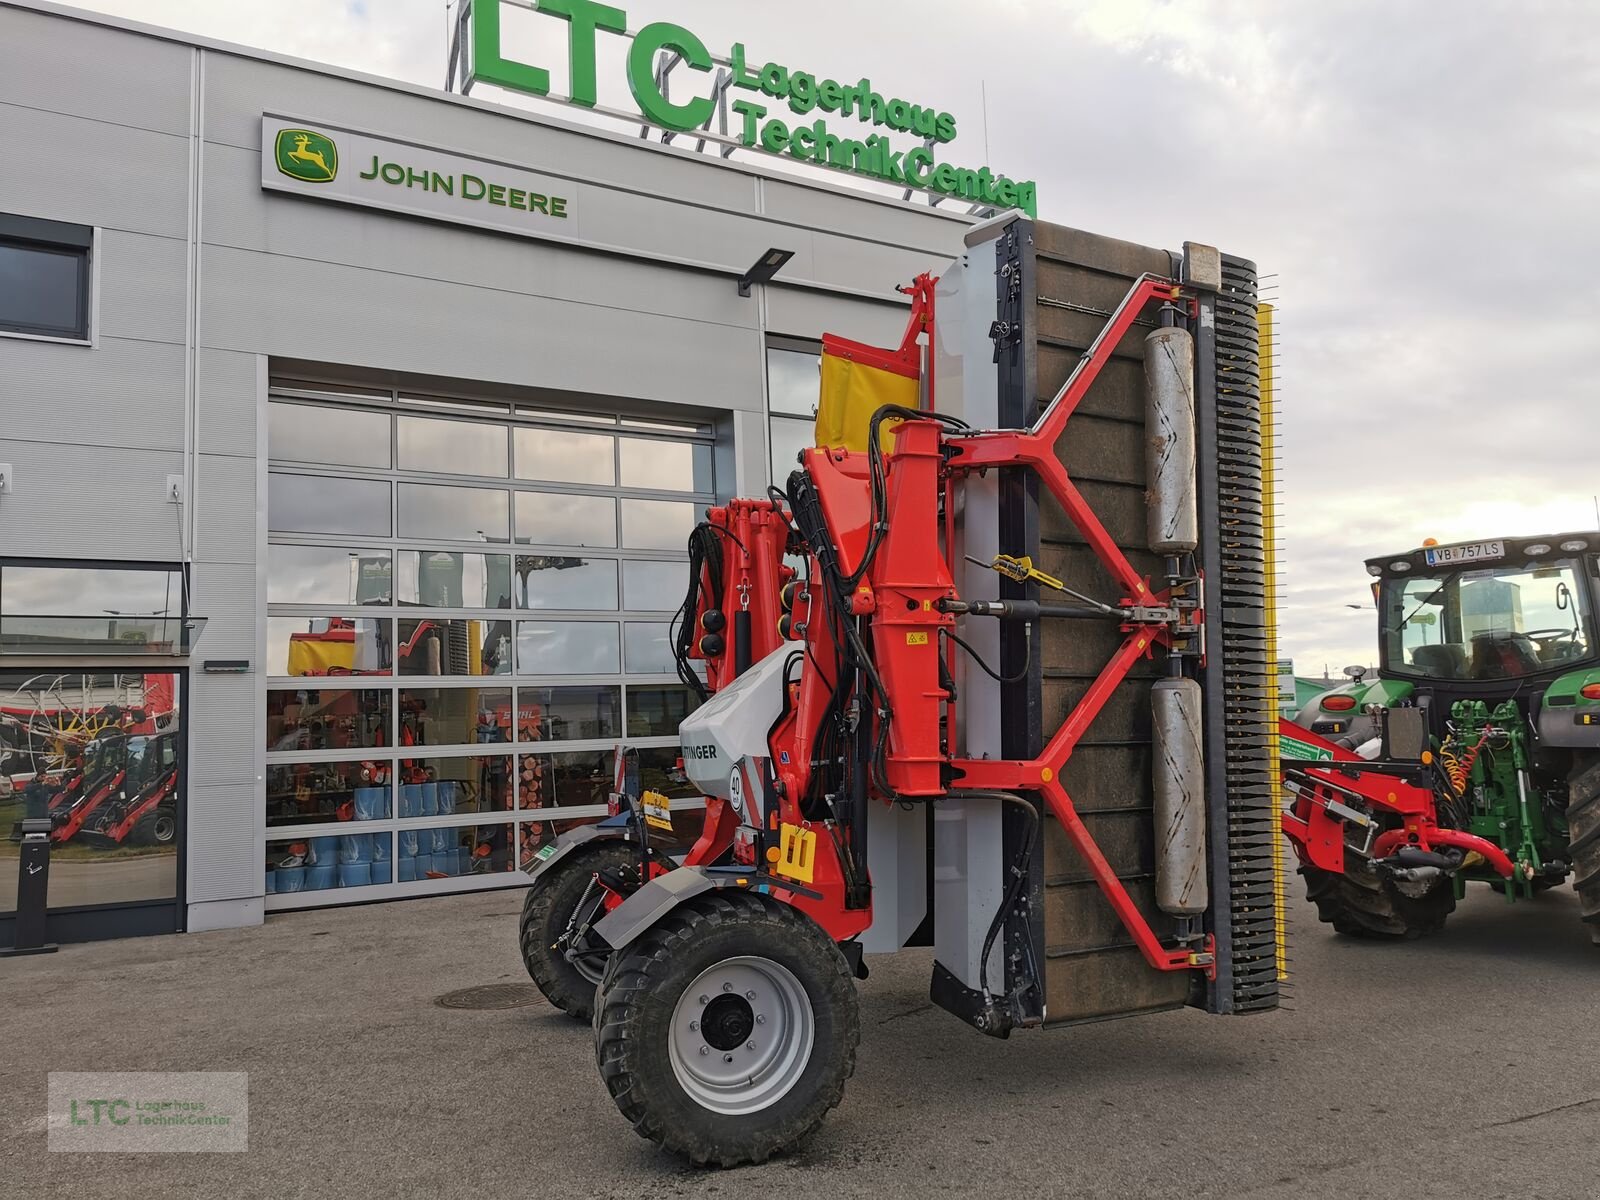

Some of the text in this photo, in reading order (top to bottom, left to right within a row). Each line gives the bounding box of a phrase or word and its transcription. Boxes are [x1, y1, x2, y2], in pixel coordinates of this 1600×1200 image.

[472, 0, 717, 132] LTC
[731, 42, 957, 144] Lagerhaus
[360, 155, 568, 219] JOHN DEERE
[732, 99, 1037, 218] TechnikCenter
[503, 711, 536, 719] SIHL
[731, 776, 740, 796] 40
